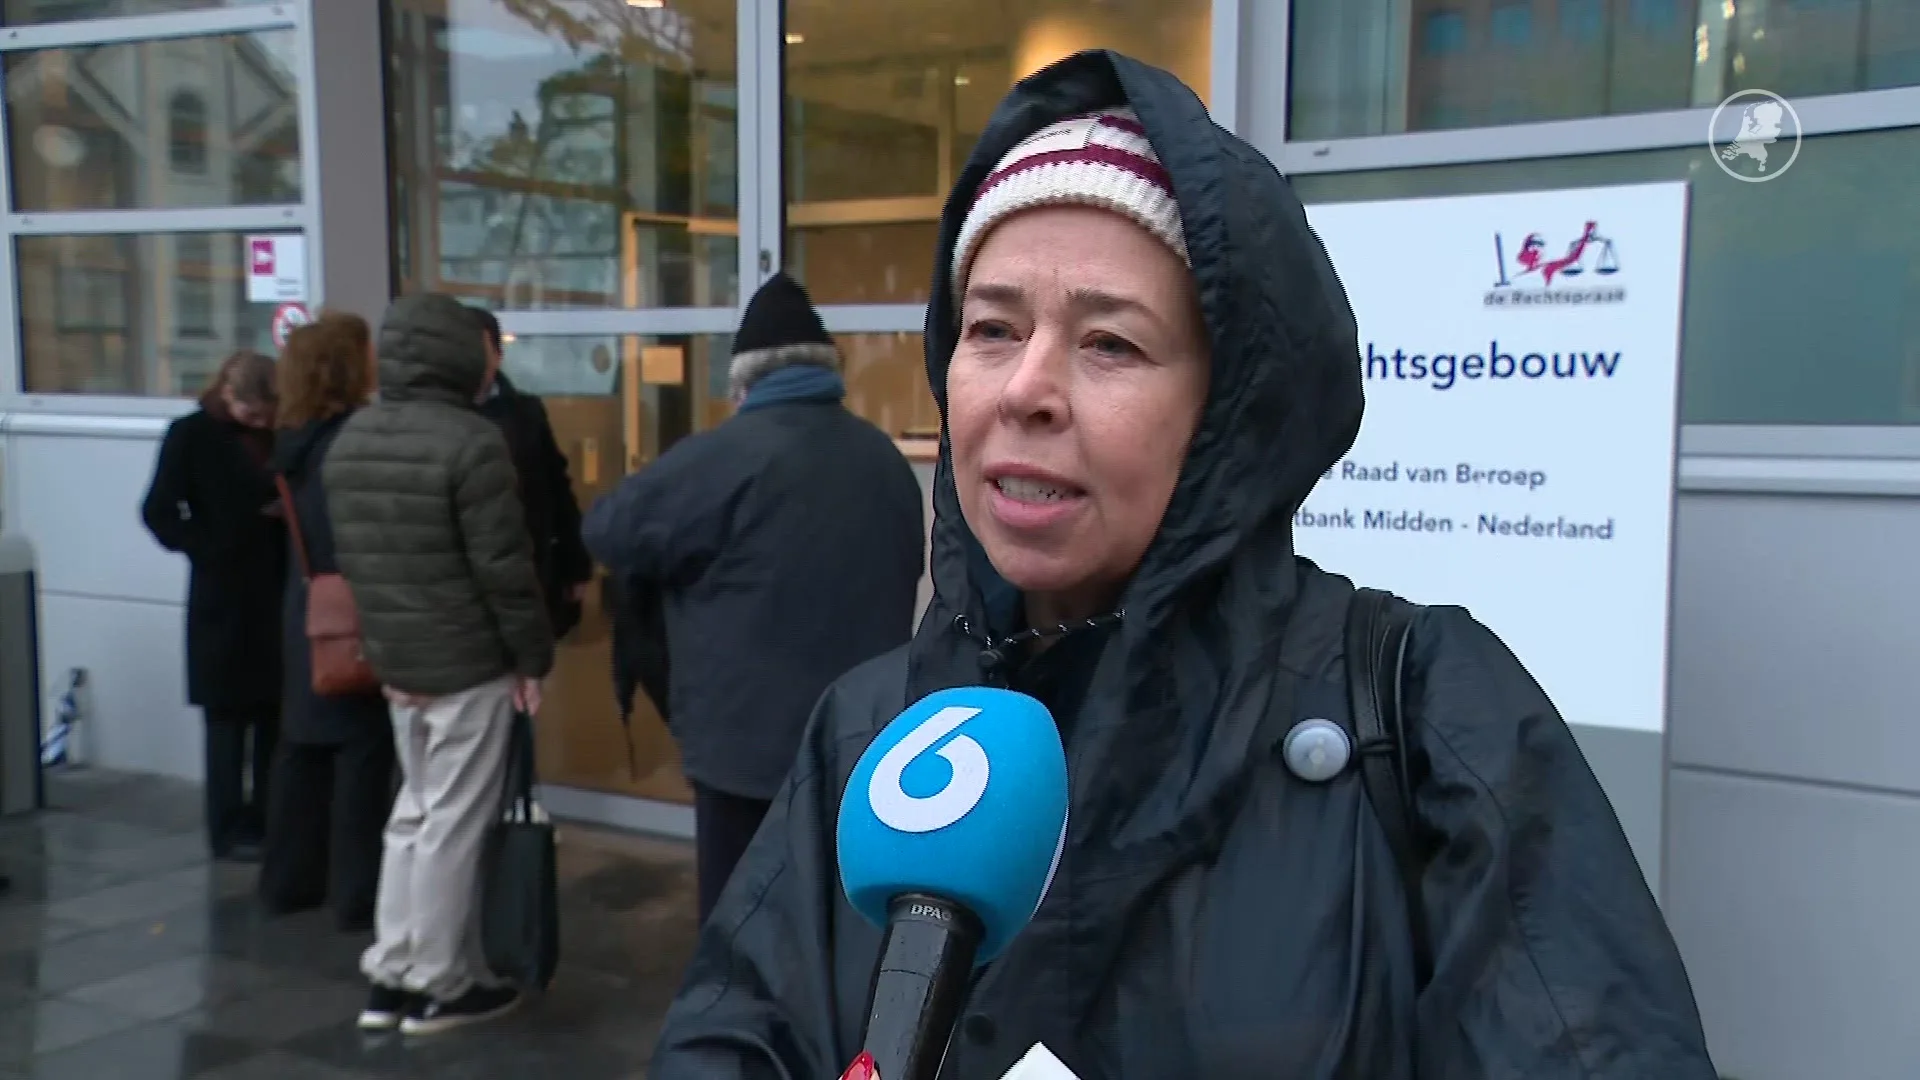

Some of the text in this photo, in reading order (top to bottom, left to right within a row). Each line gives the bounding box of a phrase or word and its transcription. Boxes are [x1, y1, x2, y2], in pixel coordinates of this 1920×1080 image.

[1361, 341, 1622, 390] htsgebouw
[1342, 460, 1398, 481] Raad
[1406, 468, 1447, 483] van
[1456, 464, 1546, 490] Beroep
[1363, 510, 1453, 532] Midden
[1477, 515, 1614, 540] Nederland
[868, 706, 990, 832] 6
